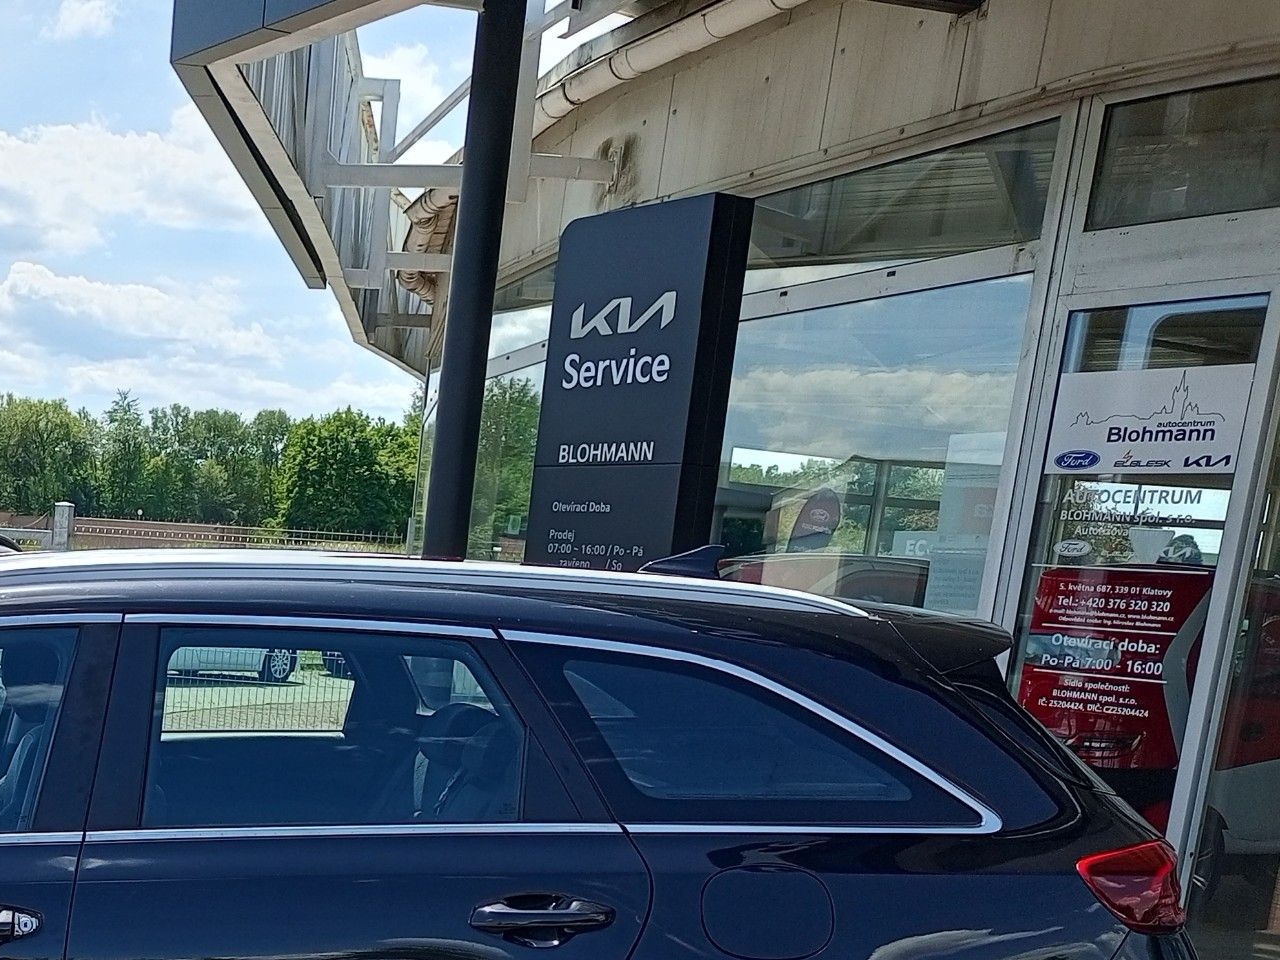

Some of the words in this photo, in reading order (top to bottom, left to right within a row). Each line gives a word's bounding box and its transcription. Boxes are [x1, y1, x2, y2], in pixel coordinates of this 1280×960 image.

[570, 290, 677, 339] KIA
[561, 348, 670, 390] Service
[1157, 420, 1215, 428] autocentrum
[1107, 426, 1215, 443] Blohmann
[558, 441, 654, 464] BLOHMANN
[1059, 453, 1094, 468] Ford
[1183, 455, 1231, 467] KIA
[1062, 489, 1202, 505] AUTOCENTRUM
[552, 501, 588, 512] Otevírací
[589, 502, 611, 512] Doba
[1060, 509, 1131, 522] BLOHMANN
[1133, 512, 1162, 526] spol.
[1166, 514, 1172, 523] s
[1175, 514, 1196, 524] r.o.
[549, 529, 575, 542] Prodej
[547, 543, 572, 553] 07:00
[581, 544, 605, 555] 16:00
[613, 545, 624, 556] Po
[632, 546, 644, 556] Pá
[1058, 541, 1088, 554] Ford
[611, 559, 622, 570] So
[1068, 583, 1095, 592] května
[1114, 585, 1128, 594] 339
[1142, 587, 1173, 598] Klatovy
[1057, 595, 1078, 607] Tel.:
[1080, 597, 1105, 608] +420
[1107, 598, 1126, 609] 376
[1128, 599, 1148, 611] 320
[1150, 601, 1170, 612] 320
[1051, 633, 1115, 650] Otevírací
[1118, 638, 1161, 653] doba:
[1041, 653, 1080, 668] Po-Pá
[1085, 657, 1112, 670] 7:00
[1126, 660, 1163, 675] 16:00
[1063, 679, 1082, 688] Sídlo
[1084, 681, 1130, 692] společnosti:
[1052, 688, 1098, 701] BLOHMANN
[1098, 693, 1118, 704] spol.
[1103, 705, 1149, 718] CZ25204424
